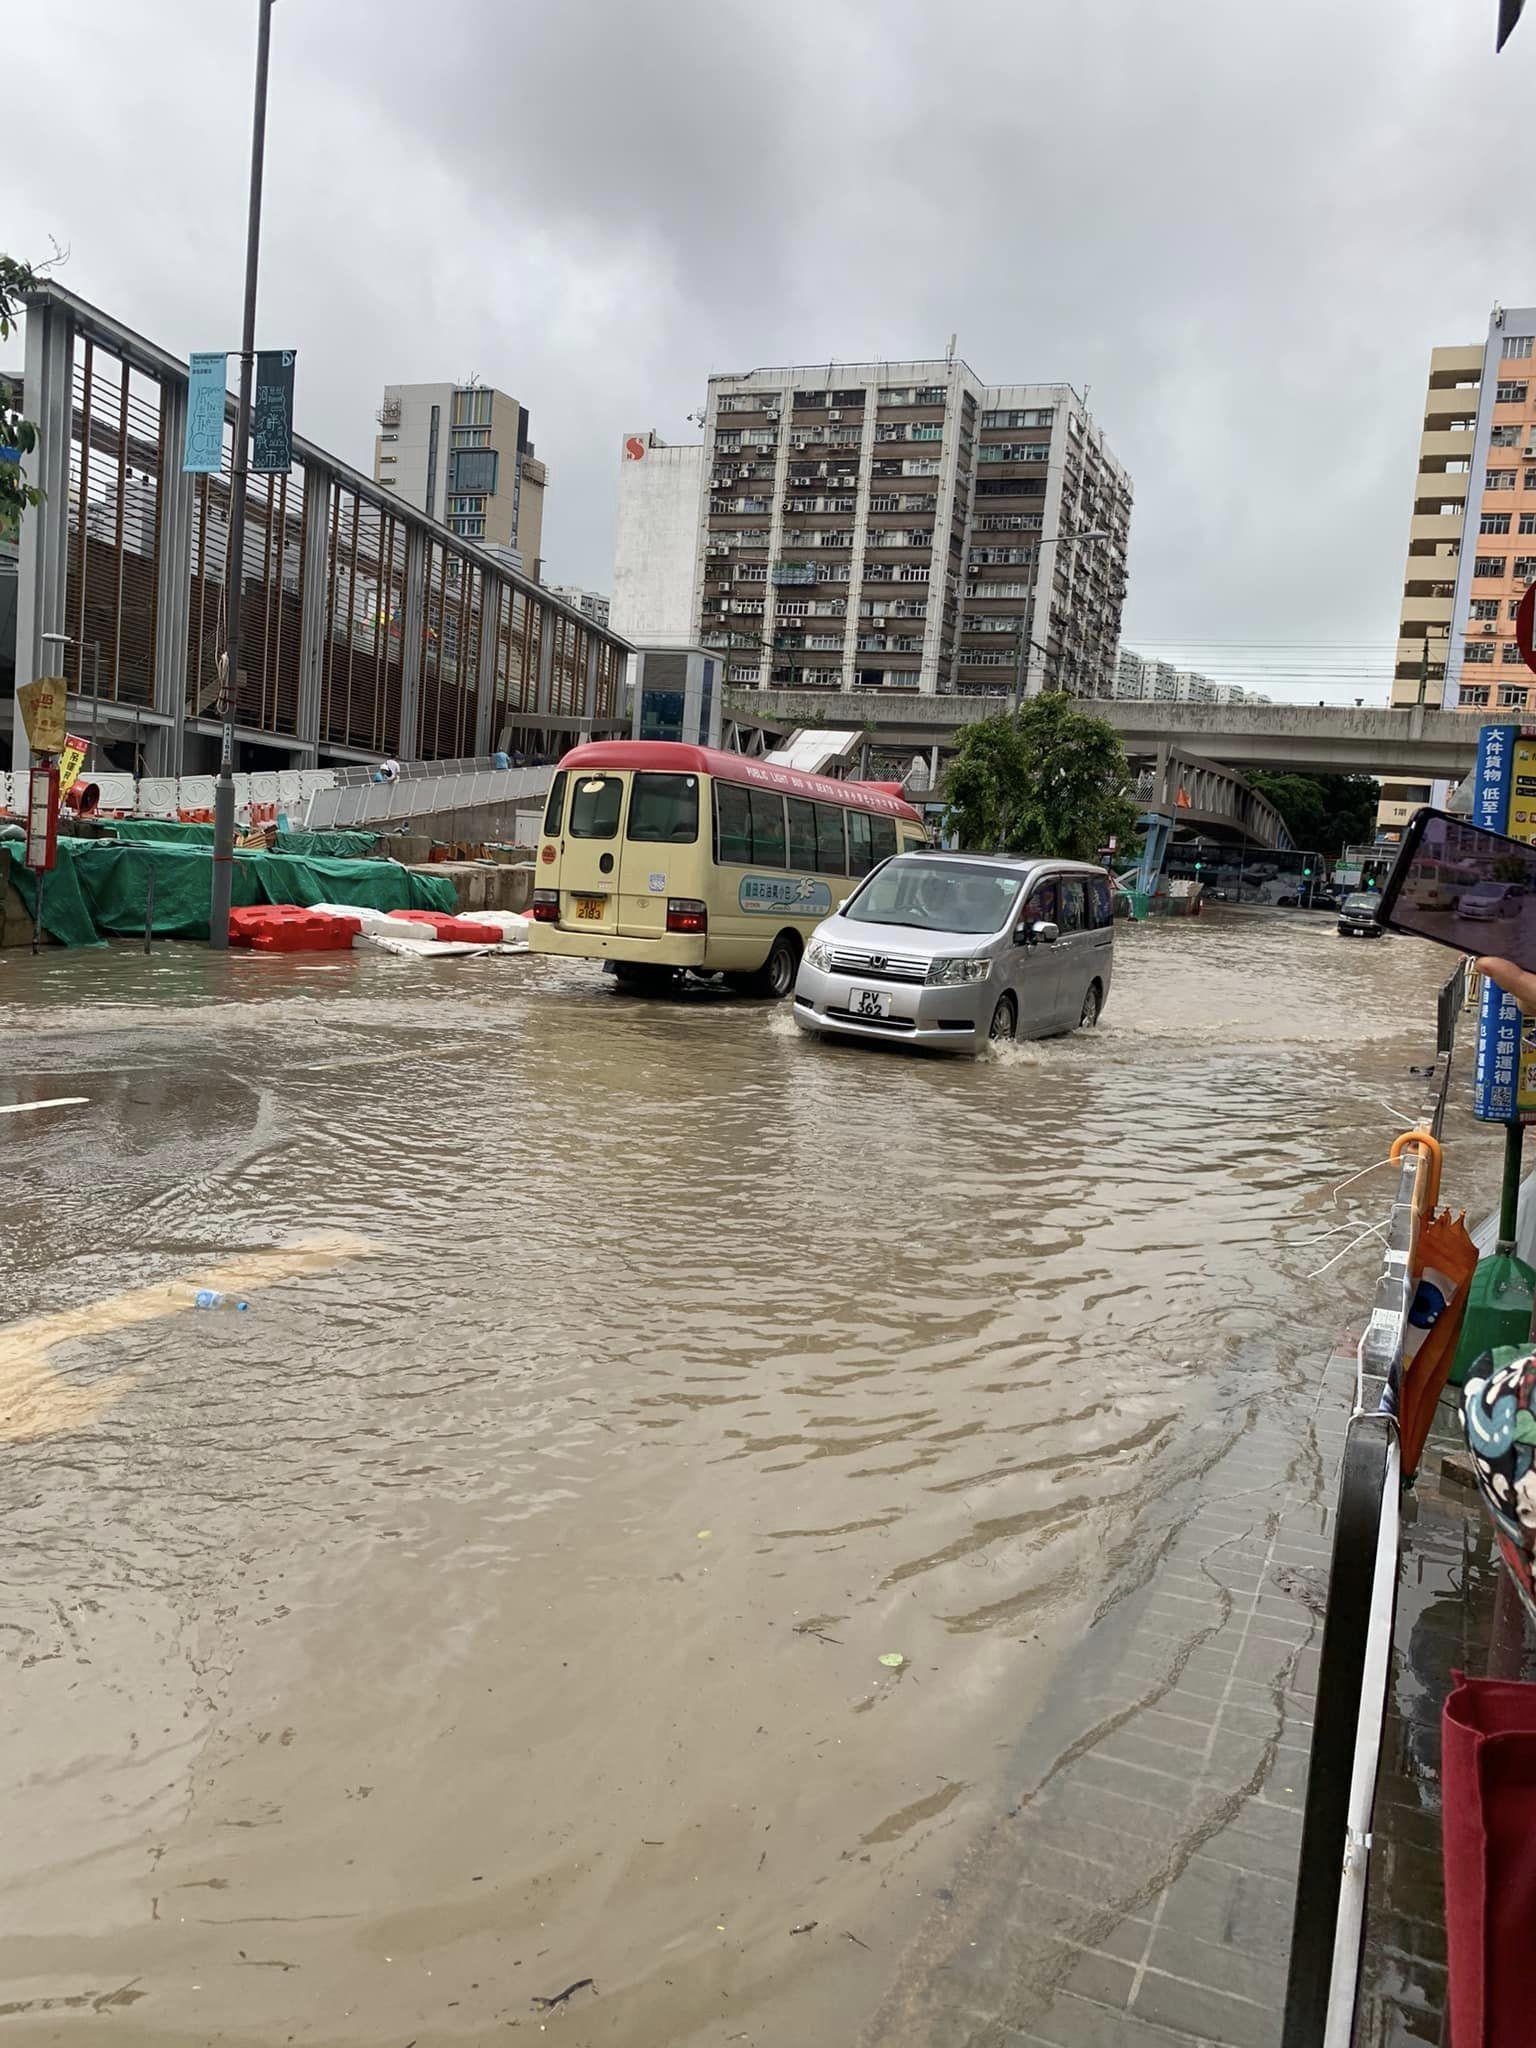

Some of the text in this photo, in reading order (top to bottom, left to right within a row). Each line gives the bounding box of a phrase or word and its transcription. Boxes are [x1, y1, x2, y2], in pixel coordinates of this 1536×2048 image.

[770, 772, 788, 785] LIGHT
[791, 777, 804, 788] BUS
[1480, 729, 1504, 831] 大件貨物 低至1
[862, 992, 880, 1004] PV
[857, 1001, 882, 1016] 362
[1494, 1025, 1515, 1085] 乜都運得
